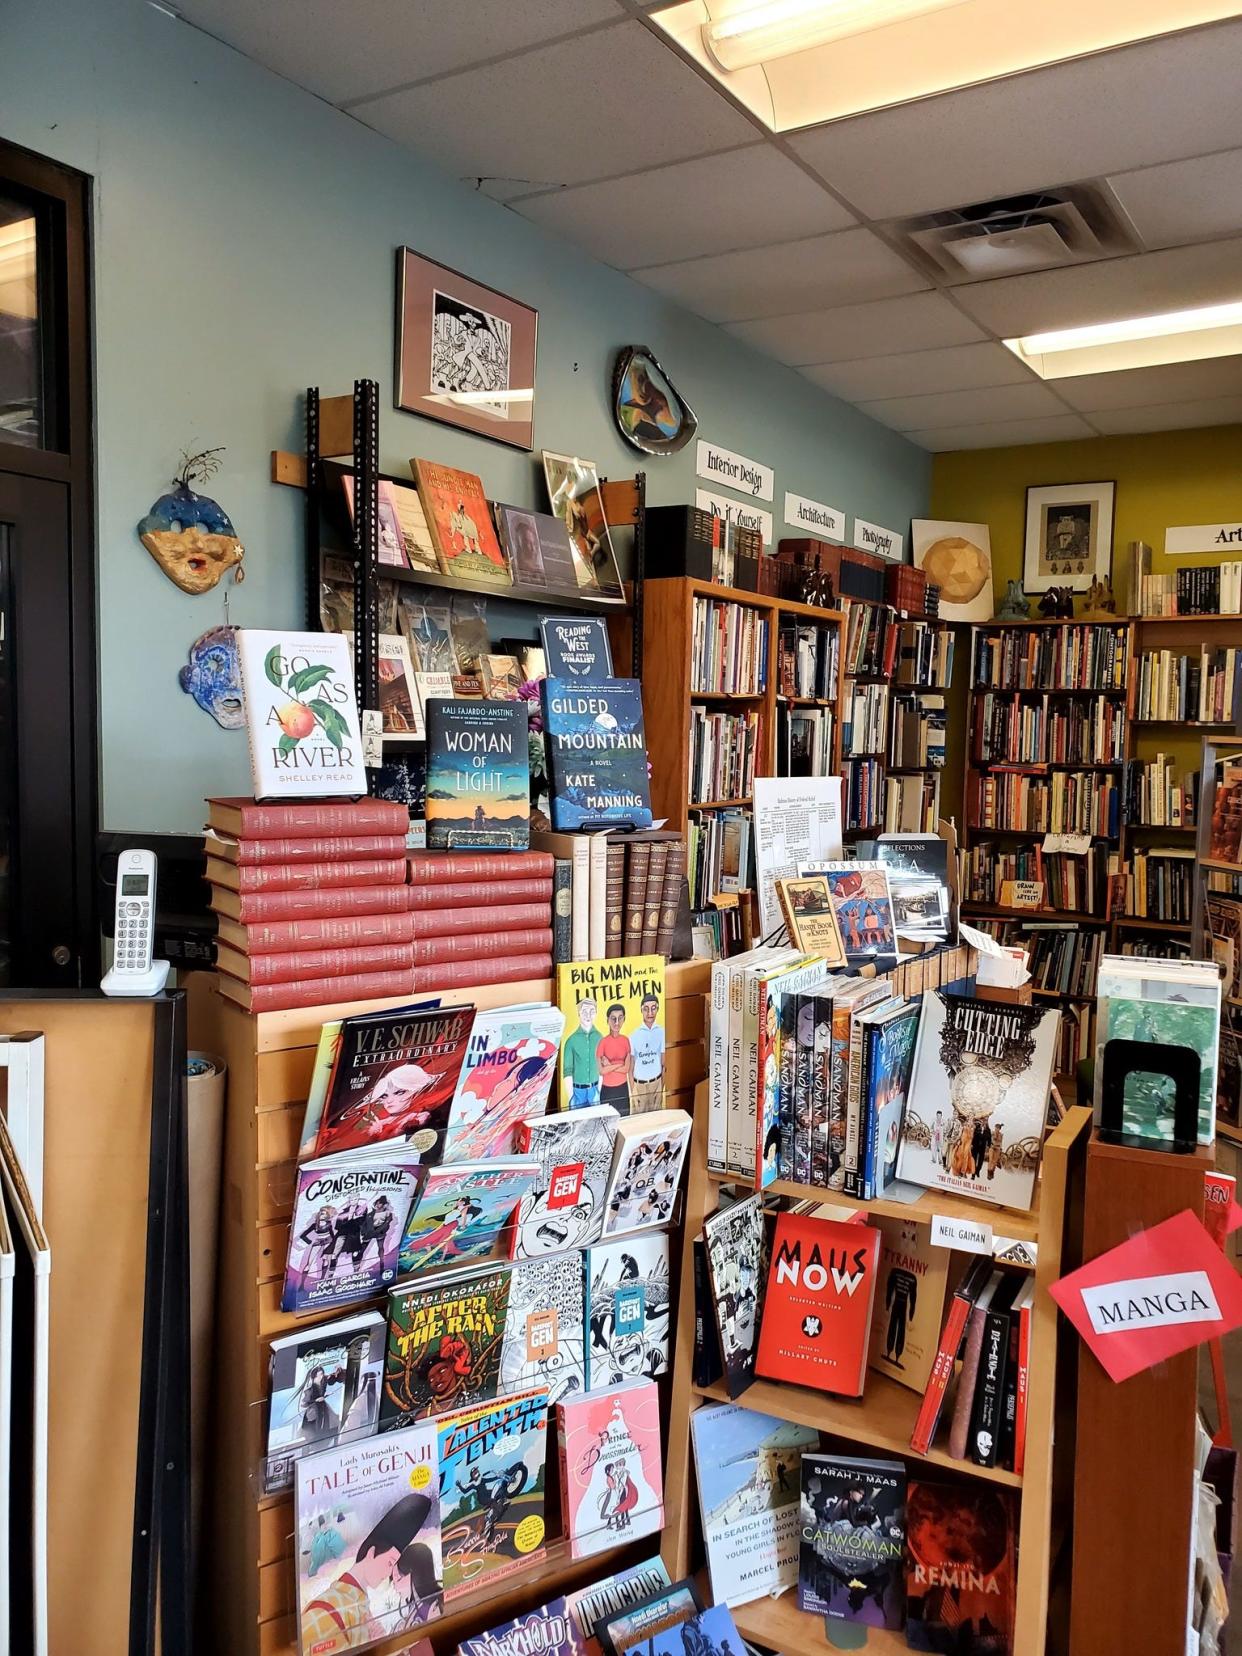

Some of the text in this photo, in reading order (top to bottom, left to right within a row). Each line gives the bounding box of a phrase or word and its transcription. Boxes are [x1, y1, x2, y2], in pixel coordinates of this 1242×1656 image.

[707, 451, 762, 495] Interior Design
[735, 507, 763, 532] Yourself
[797, 502, 836, 529] Architecture
[862, 527, 892, 554] Photography
[555, 625, 591, 640] READING
[563, 637, 589, 651] WEST
[270, 655, 310, 677] GO
[562, 656, 595, 664] FINALIST
[317, 682, 349, 703] AS
[266, 705, 286, 726] A
[442, 706, 514, 717] KALI FAJARDO-ANSTINE
[551, 698, 608, 714] GILDED
[445, 731, 512, 754] WOMAN
[558, 733, 643, 750] MOUNTAIN
[272, 747, 354, 769] RIVER
[472, 756, 487, 768] OF
[279, 774, 323, 783] SHELLEY
[457, 771, 503, 792] LIGHT
[565, 775, 596, 787] KATE
[587, 795, 643, 808] MANNING
[808, 861, 878, 871] OPOSSUM
[571, 964, 647, 985] BIG MAN and
[774, 965, 823, 993] NEIL GAIMAN
[575, 980, 662, 1005] LITTLE MEN
[387, 1017, 464, 1050] SCHWAB
[954, 1007, 1021, 1040] CUTTING
[470, 1034, 490, 1052] IN
[965, 1030, 1005, 1059] EDGE
[466, 1049, 518, 1068] LIMBO
[713, 1035, 722, 1109] NEIL GAIMAN
[731, 1038, 740, 1111] NEIL GAIMAN
[748, 1042, 758, 1116] NEIL GAIMAN
[780, 1050, 790, 1113] SANDMAN
[849, 1050, 860, 1104] AMERICAN GODS
[797, 1052, 807, 1115] SANDMAN
[814, 1054, 824, 1118] SANDMAN
[832, 1056, 842, 1122] SANDMAN
[732, 1151, 738, 1159] 2
[848, 1157, 854, 1165] 2
[444, 1172, 524, 1185] ANOTHER
[796, 1167, 807, 1177] DC
[814, 1170, 824, 1180] DC
[305, 1170, 411, 1201] CONSTANTINE
[324, 1186, 365, 1202] DISTORTED
[434, 1178, 520, 1194] CASTLE
[553, 1180, 577, 1197] GEN
[940, 1225, 986, 1244] NEIL GAIMAN
[775, 1238, 867, 1278] MAUS
[884, 1247, 929, 1277] TYRANNY
[316, 1271, 371, 1290] KAMI GARCIA
[382, 1270, 393, 1280] DC
[776, 1257, 864, 1298] NOW
[308, 1279, 377, 1298] ISAAC GOODHART
[402, 1295, 439, 1309] NNEDI
[443, 1279, 503, 1299] OKORAFOR
[413, 1296, 487, 1331] AFTER
[619, 1304, 641, 1323] GEN
[1097, 1289, 1210, 1325] MANGA
[397, 1313, 497, 1357] THE RAIN
[530, 1329, 554, 1348] GEN
[778, 1348, 837, 1367] HILLARY CHUTE
[933, 1351, 945, 1375] MAUS
[942, 1354, 953, 1379] MAUS
[1019, 1367, 1027, 1392] MAUS
[438, 1394, 549, 1460] TALENTED
[598, 1430, 632, 1447] PRINCE
[340, 1455, 358, 1467] Lady
[438, 1410, 541, 1498] TENTH
[581, 1441, 648, 1476] Dressmaker
[305, 1466, 358, 1495] TALE
[378, 1444, 432, 1474] GENJI
[814, 1466, 852, 1480] SARAH
[855, 1473, 863, 1482] J.
[866, 1475, 897, 1487] MAAS
[713, 1508, 799, 1543] IN SEARCH OF LOST
[735, 1521, 794, 1547] IN THE SHADOW
[889, 1527, 901, 1537] DC
[725, 1545, 752, 1560] YOUNG
[753, 1539, 776, 1553] GIRLS
[777, 1535, 785, 1543] IN
[802, 1526, 901, 1557] CATWOMAN
[821, 1543, 884, 1561] SOULSTEALER
[739, 1563, 775, 1582] MARCEL
[914, 1564, 1001, 1596] REMINA
